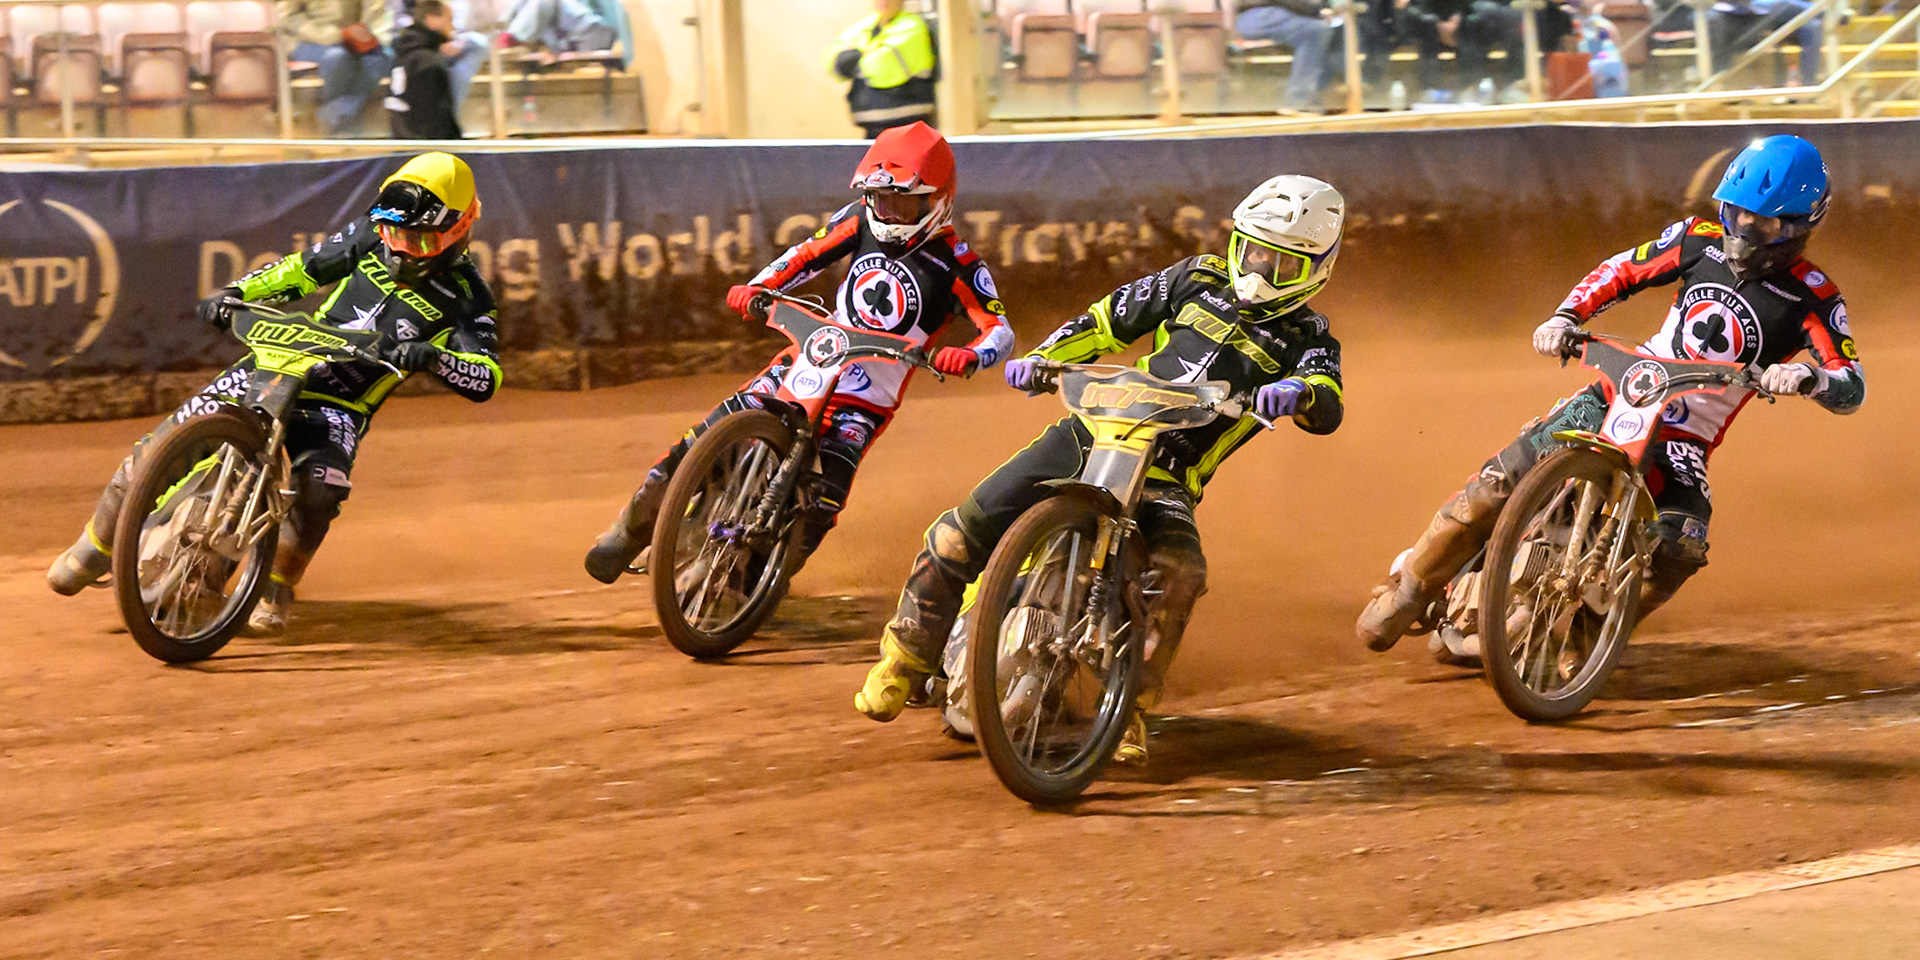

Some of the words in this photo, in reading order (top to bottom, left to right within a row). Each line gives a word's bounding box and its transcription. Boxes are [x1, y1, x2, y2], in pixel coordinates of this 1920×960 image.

[852, 258, 882, 277] BELLE
[884, 260, 906, 280] VUE
[902, 282, 918, 312] ACES
[397, 320, 419, 341] 75
[1720, 291, 1744, 315] VUE
[1741, 318, 1758, 349] ACES
[797, 376, 818, 389] ATPI
[1616, 419, 1639, 432] ATPI
